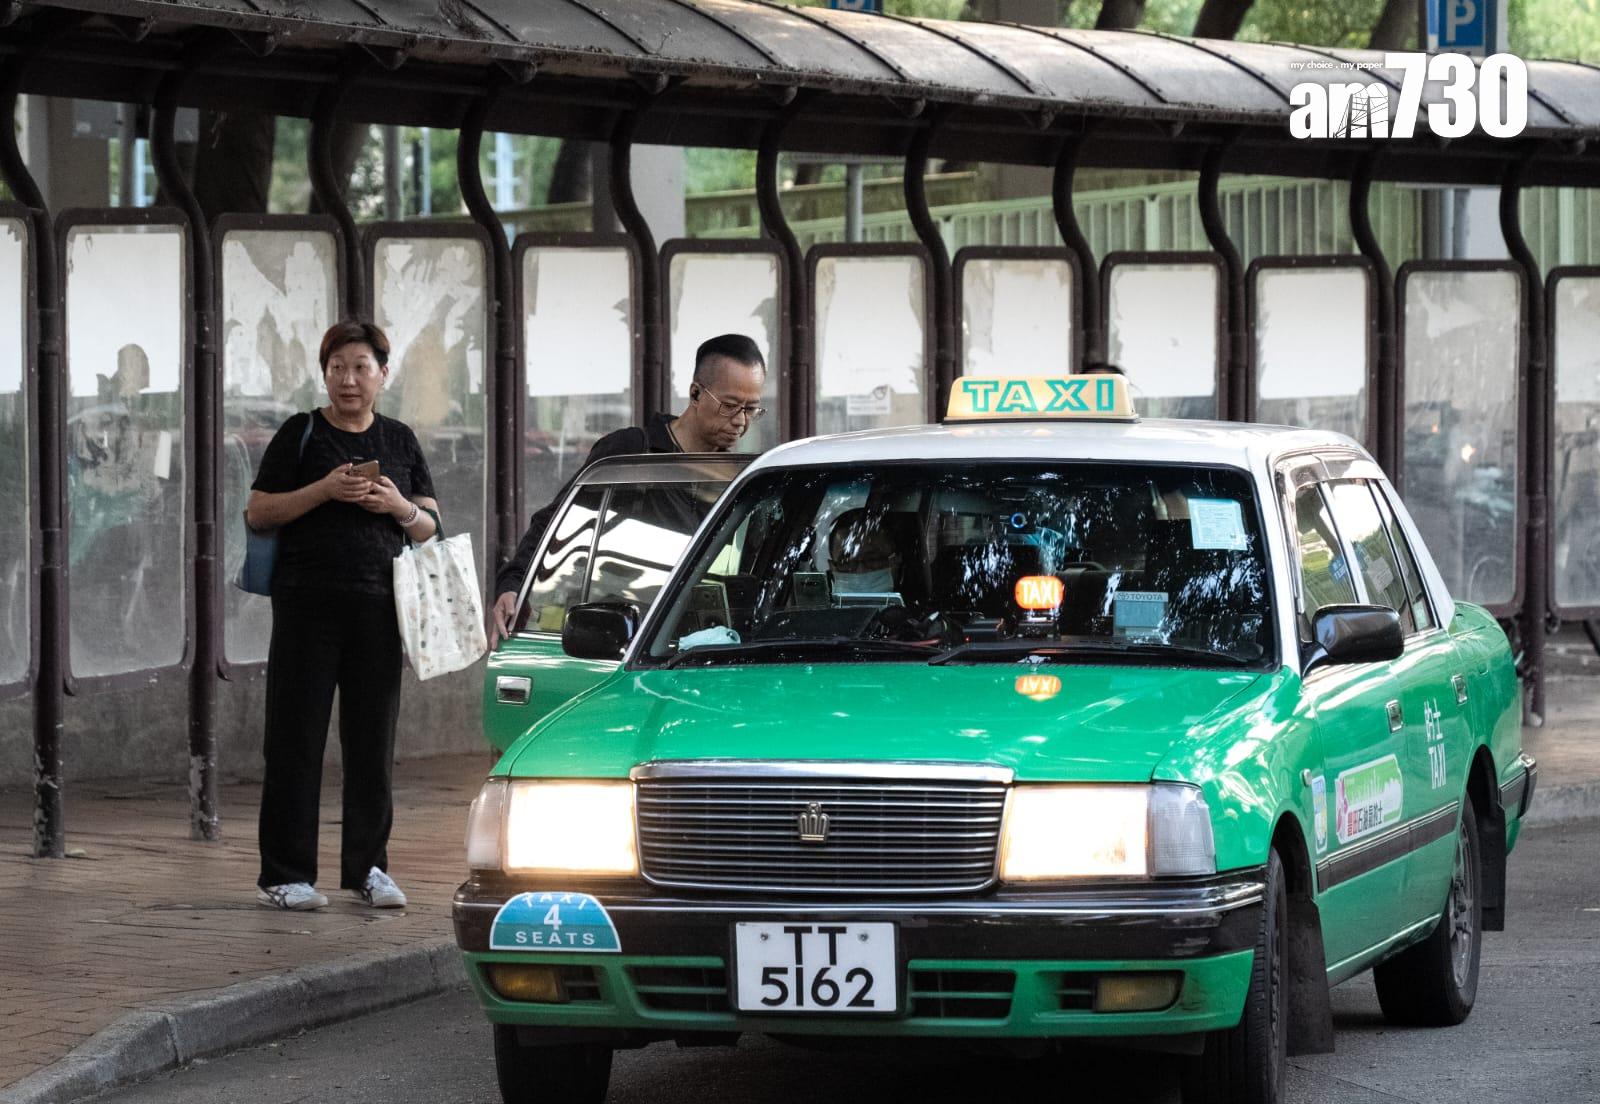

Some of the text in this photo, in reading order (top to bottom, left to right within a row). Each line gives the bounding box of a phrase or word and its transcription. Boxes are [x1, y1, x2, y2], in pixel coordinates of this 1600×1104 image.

[962, 379, 1116, 412] TAXI
[1020, 580, 1060, 605] TAXI
[1131, 593, 1163, 601] TOYOTA
[1424, 697, 1443, 742] 的士
[1428, 743, 1446, 790] TAXI
[522, 893, 587, 910] TAXI
[543, 903, 562, 930] 4
[515, 931, 595, 946] SEATS
[783, 926, 847, 966] TT
[760, 967, 875, 1007] 5162
